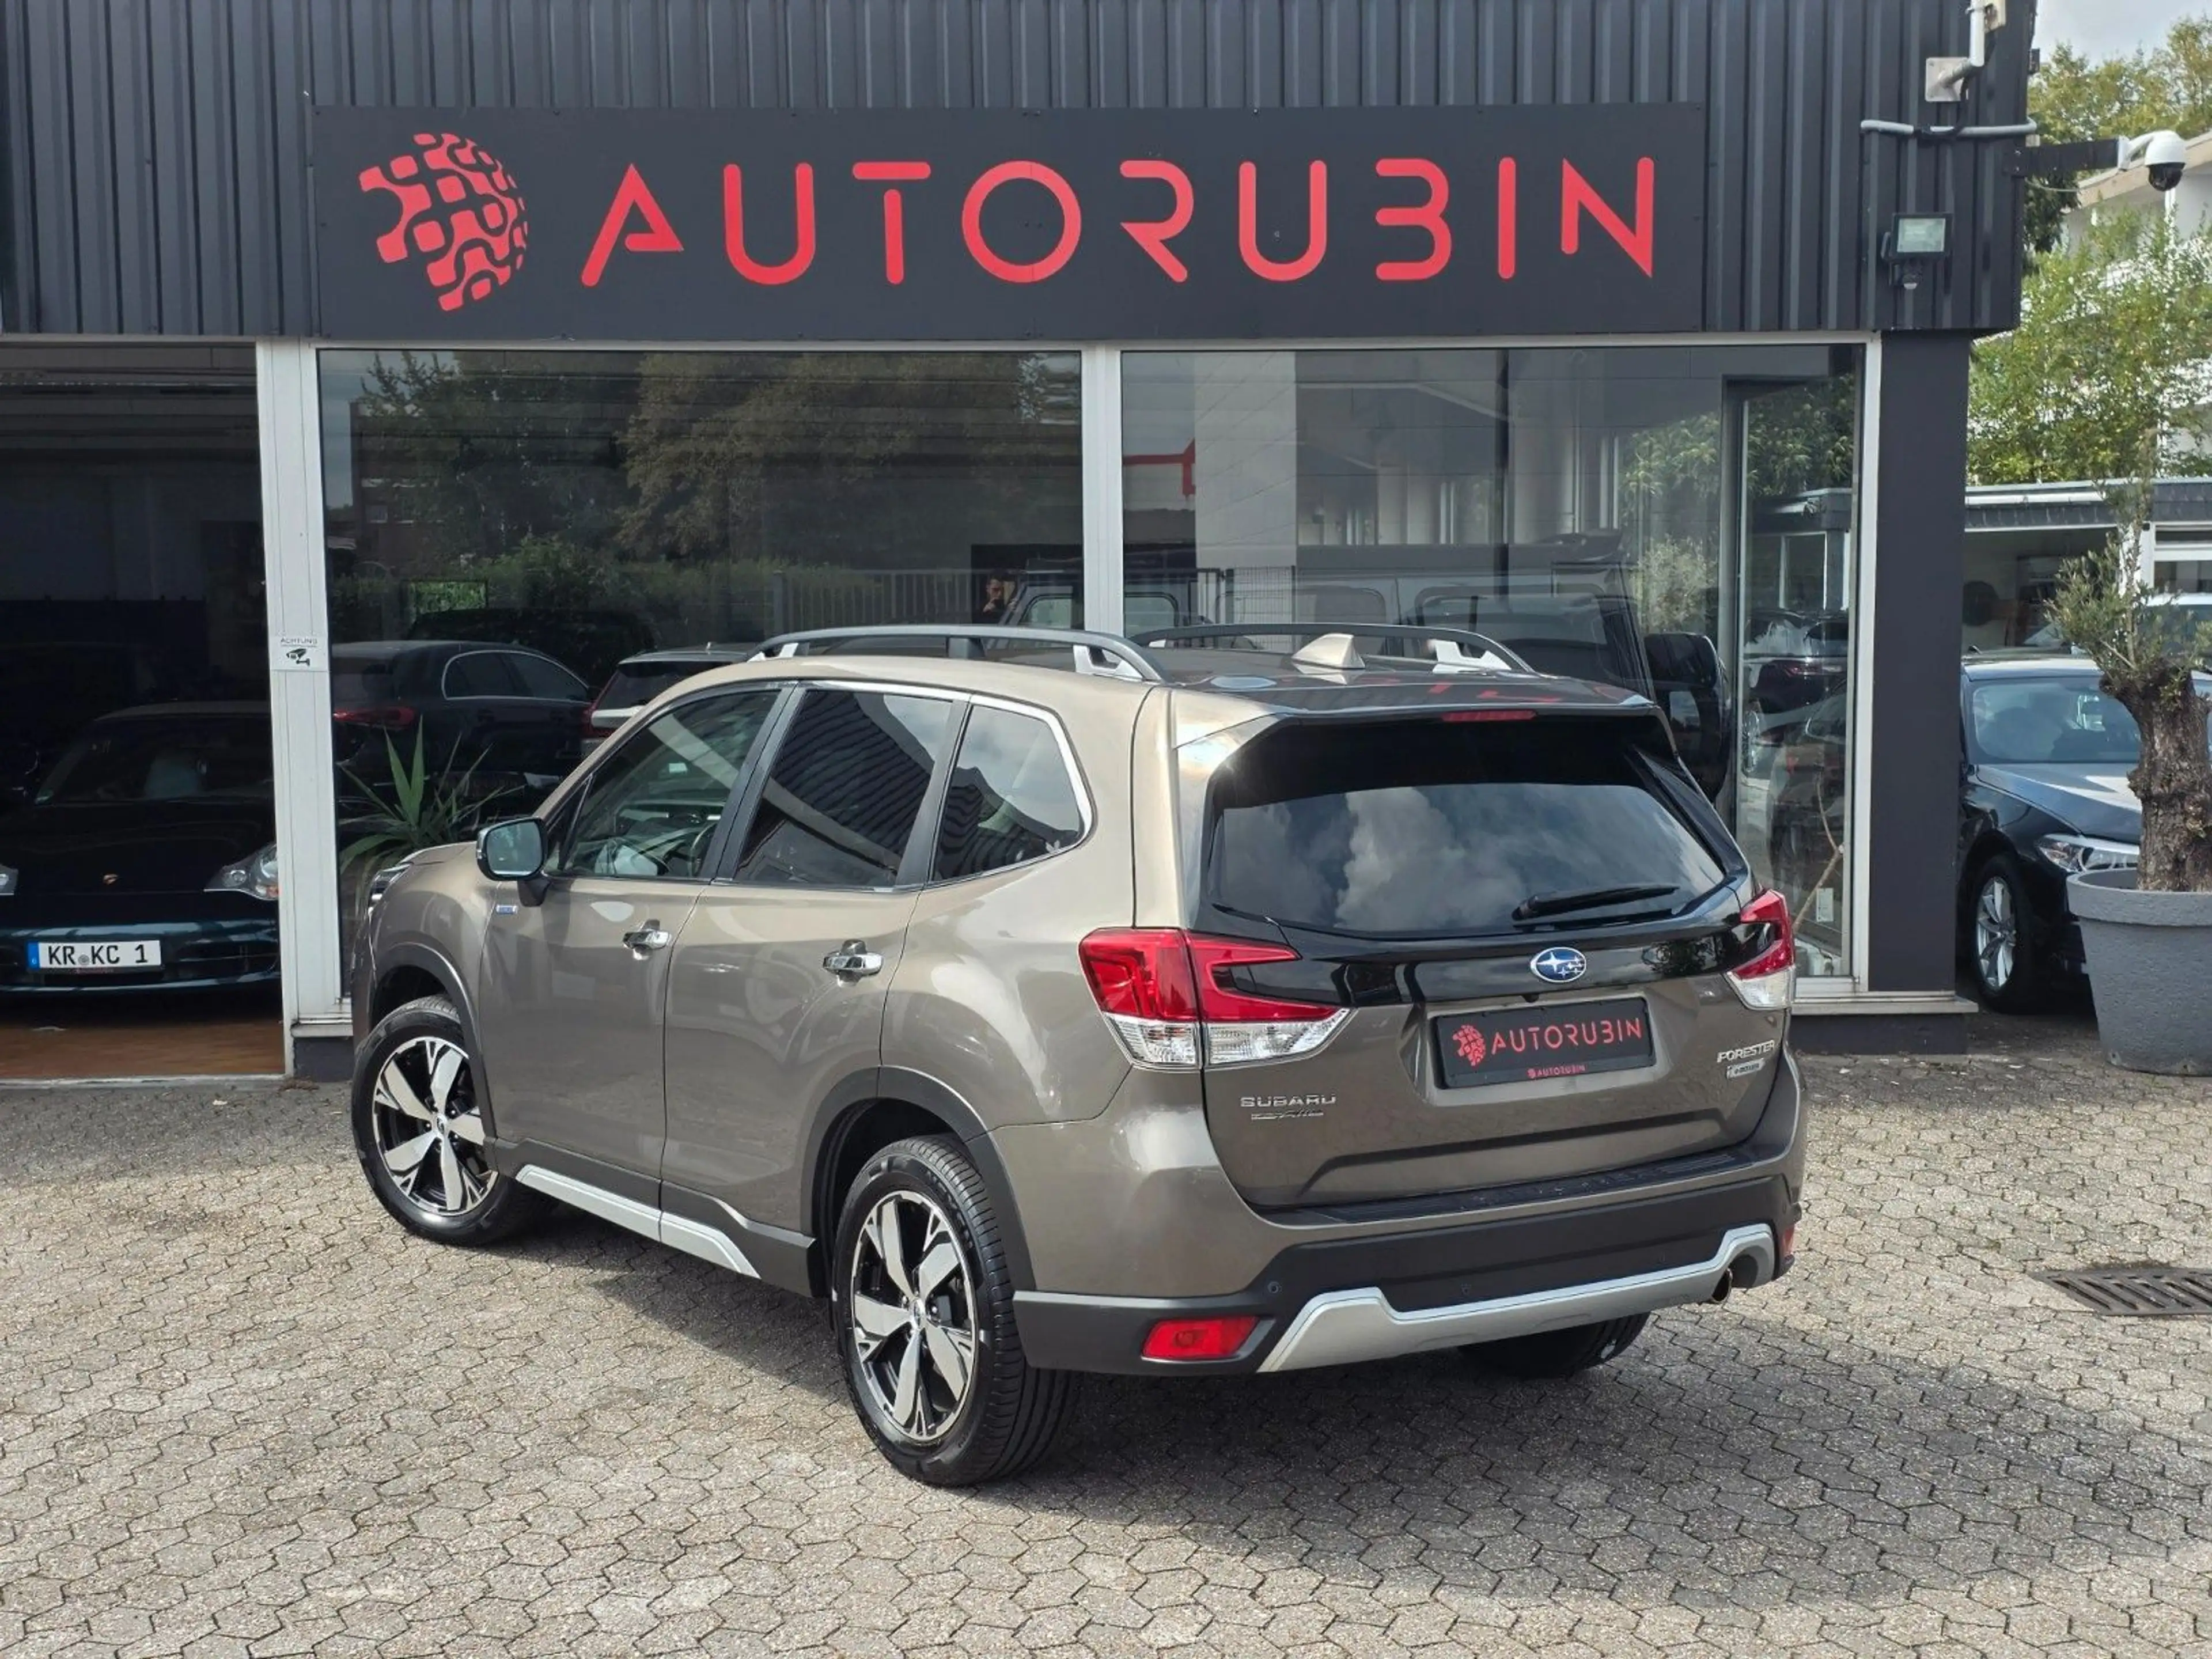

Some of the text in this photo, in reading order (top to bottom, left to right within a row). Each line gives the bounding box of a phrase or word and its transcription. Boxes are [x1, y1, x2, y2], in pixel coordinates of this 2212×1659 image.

[581, 156, 1656, 288] AUTORUBIN
[48, 944, 149, 965] KR KC 1
[1491, 1017, 1642, 1055] AUTORUBIN
[1717, 1039, 1775, 1063] FORESTER
[1240, 1093, 1337, 1108] SUBARU
